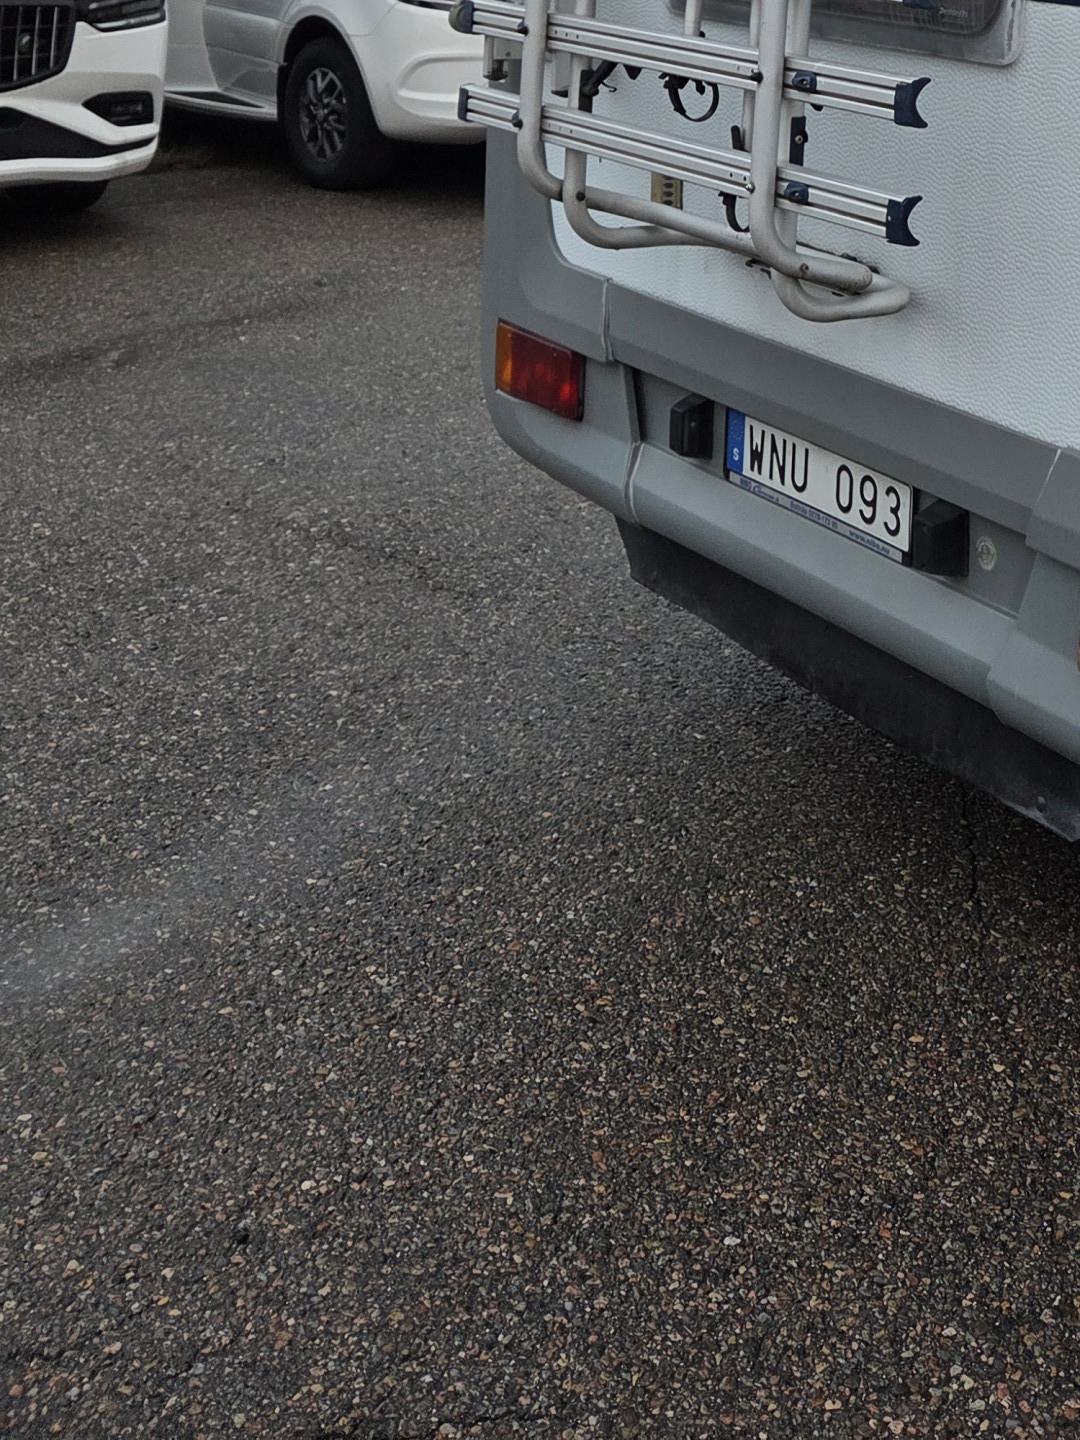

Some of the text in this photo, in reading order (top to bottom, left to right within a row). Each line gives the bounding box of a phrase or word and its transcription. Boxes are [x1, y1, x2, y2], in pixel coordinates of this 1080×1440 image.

[732, 447, 740, 461] S
[749, 424, 900, 536] WNU 093
